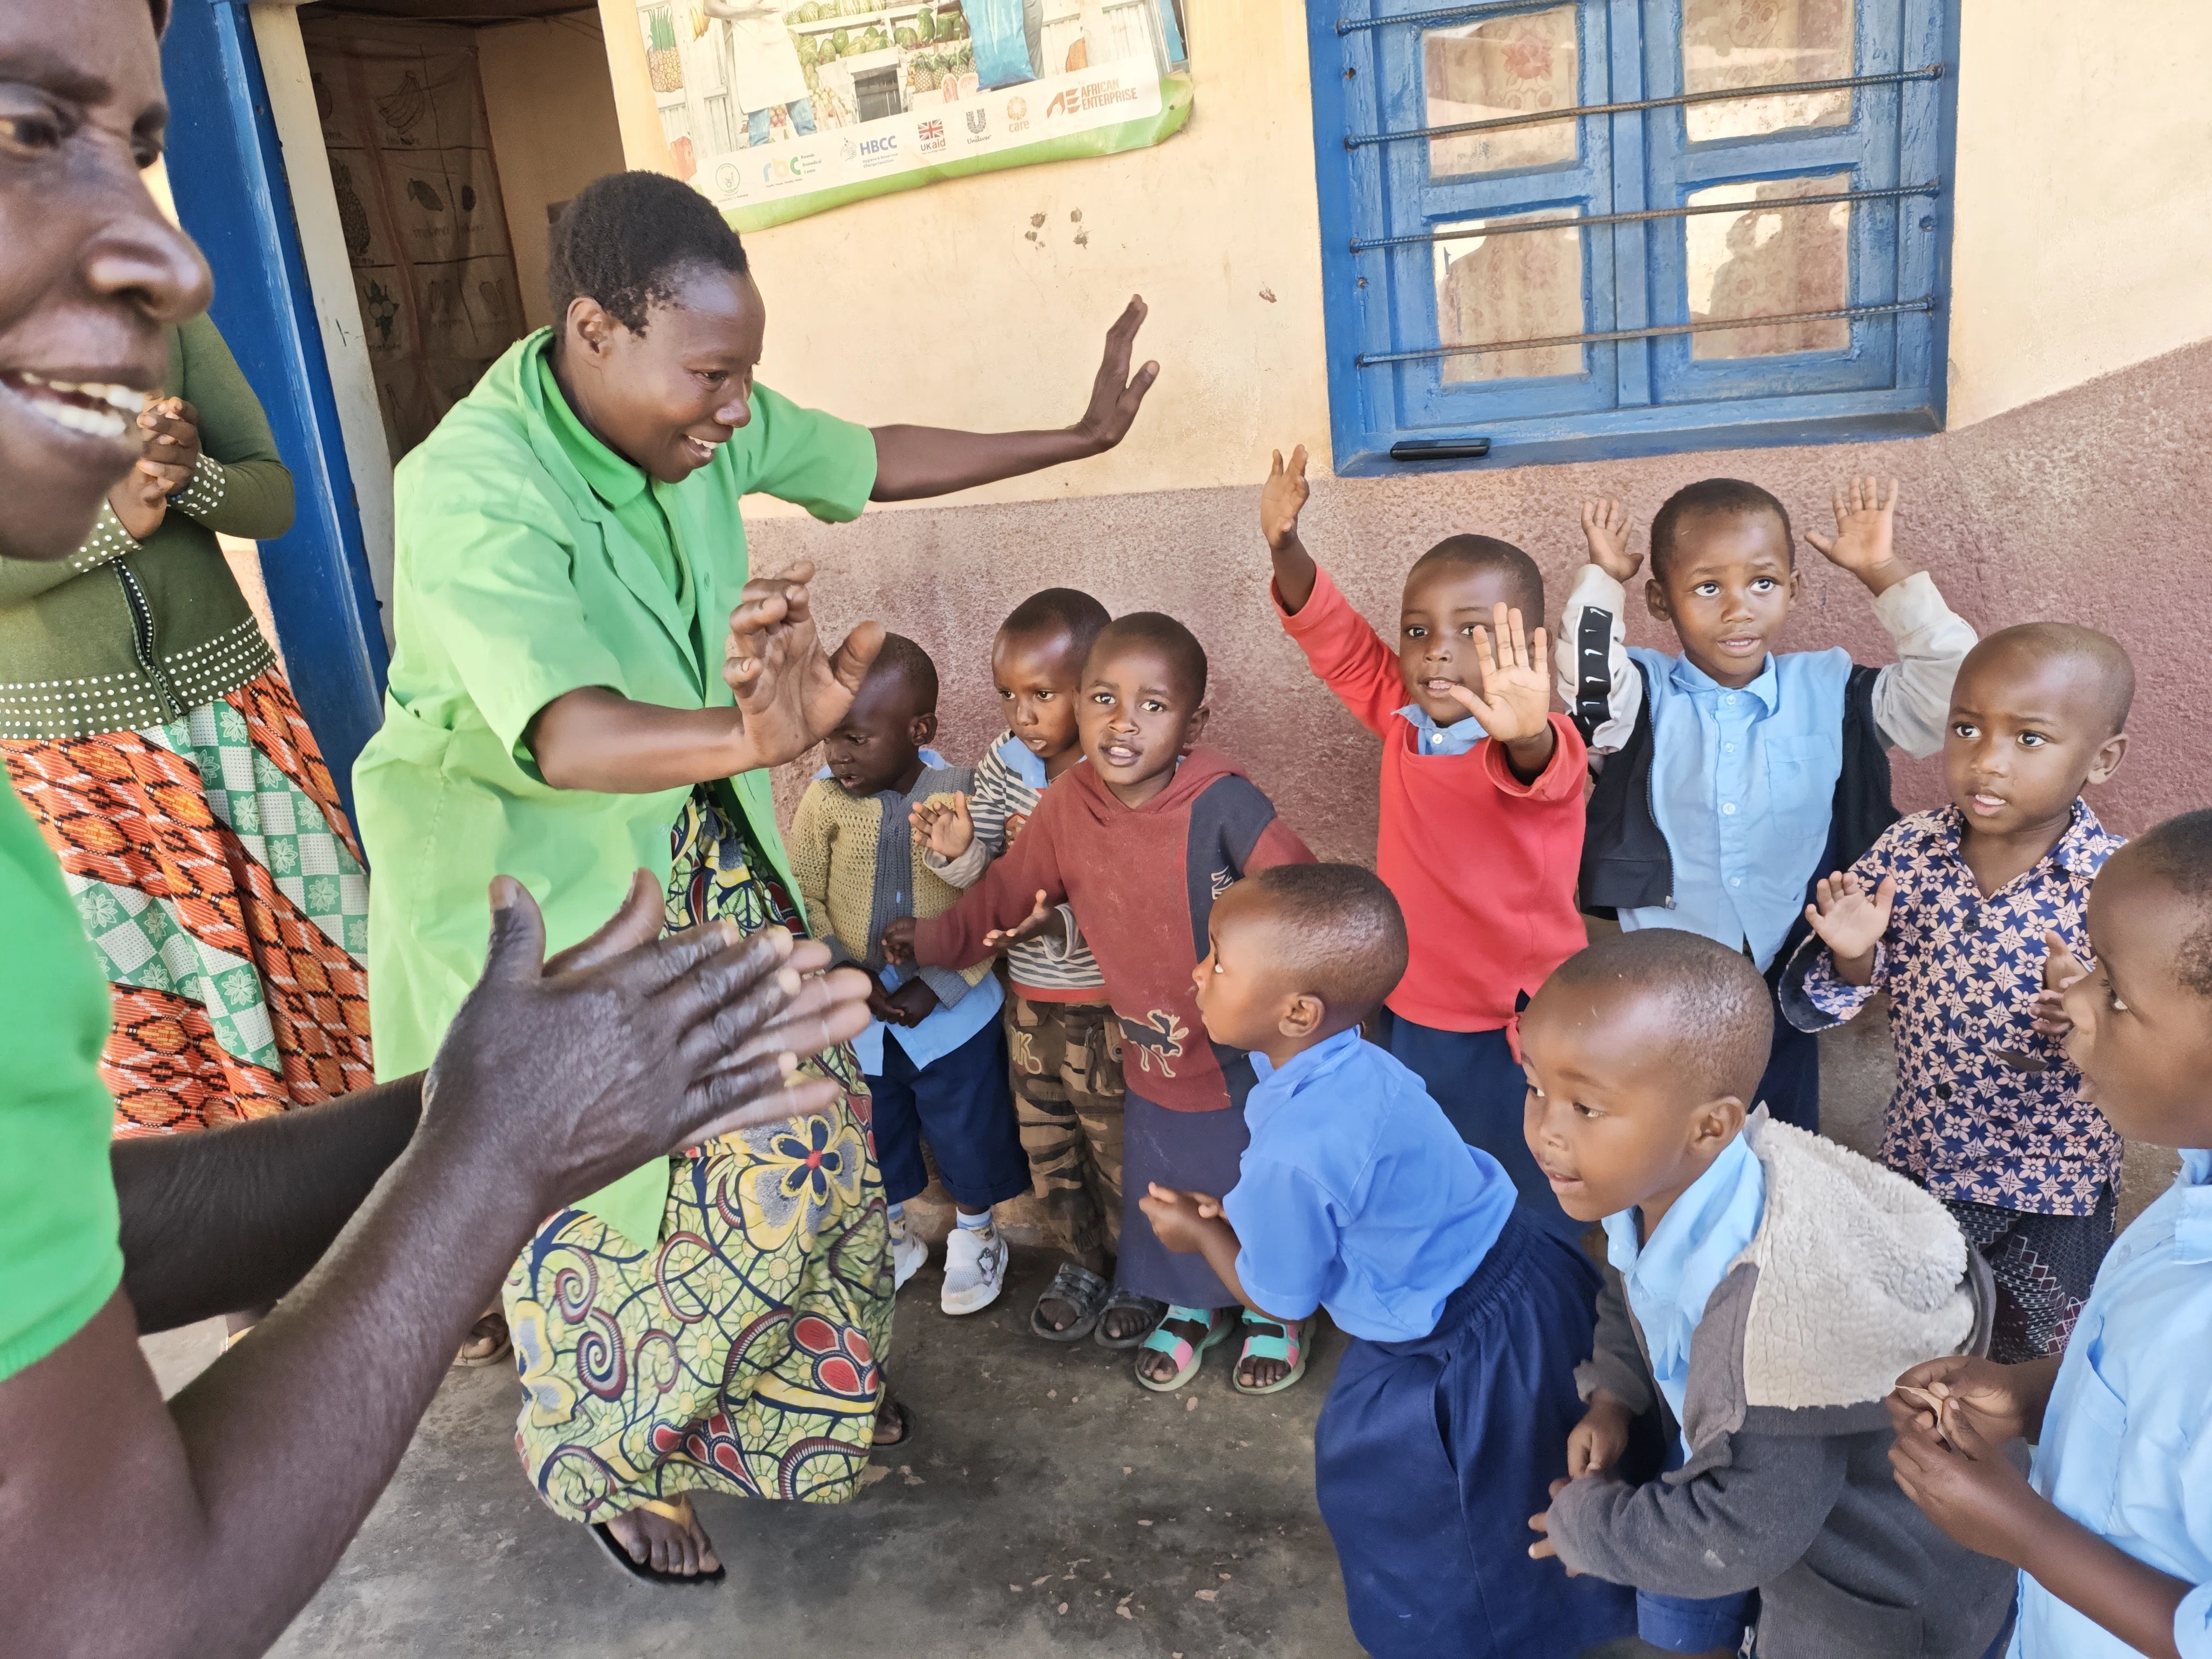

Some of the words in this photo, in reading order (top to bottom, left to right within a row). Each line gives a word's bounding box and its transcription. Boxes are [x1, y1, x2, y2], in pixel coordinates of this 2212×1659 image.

[1081, 78, 1120, 98] AFRICAN
[1082, 87, 1138, 110] ENTERPRISE
[1009, 120, 1030, 133] care
[859, 135, 898, 156] HBCC
[967, 135, 992, 144] Unilever
[763, 156, 801, 183] rbc
